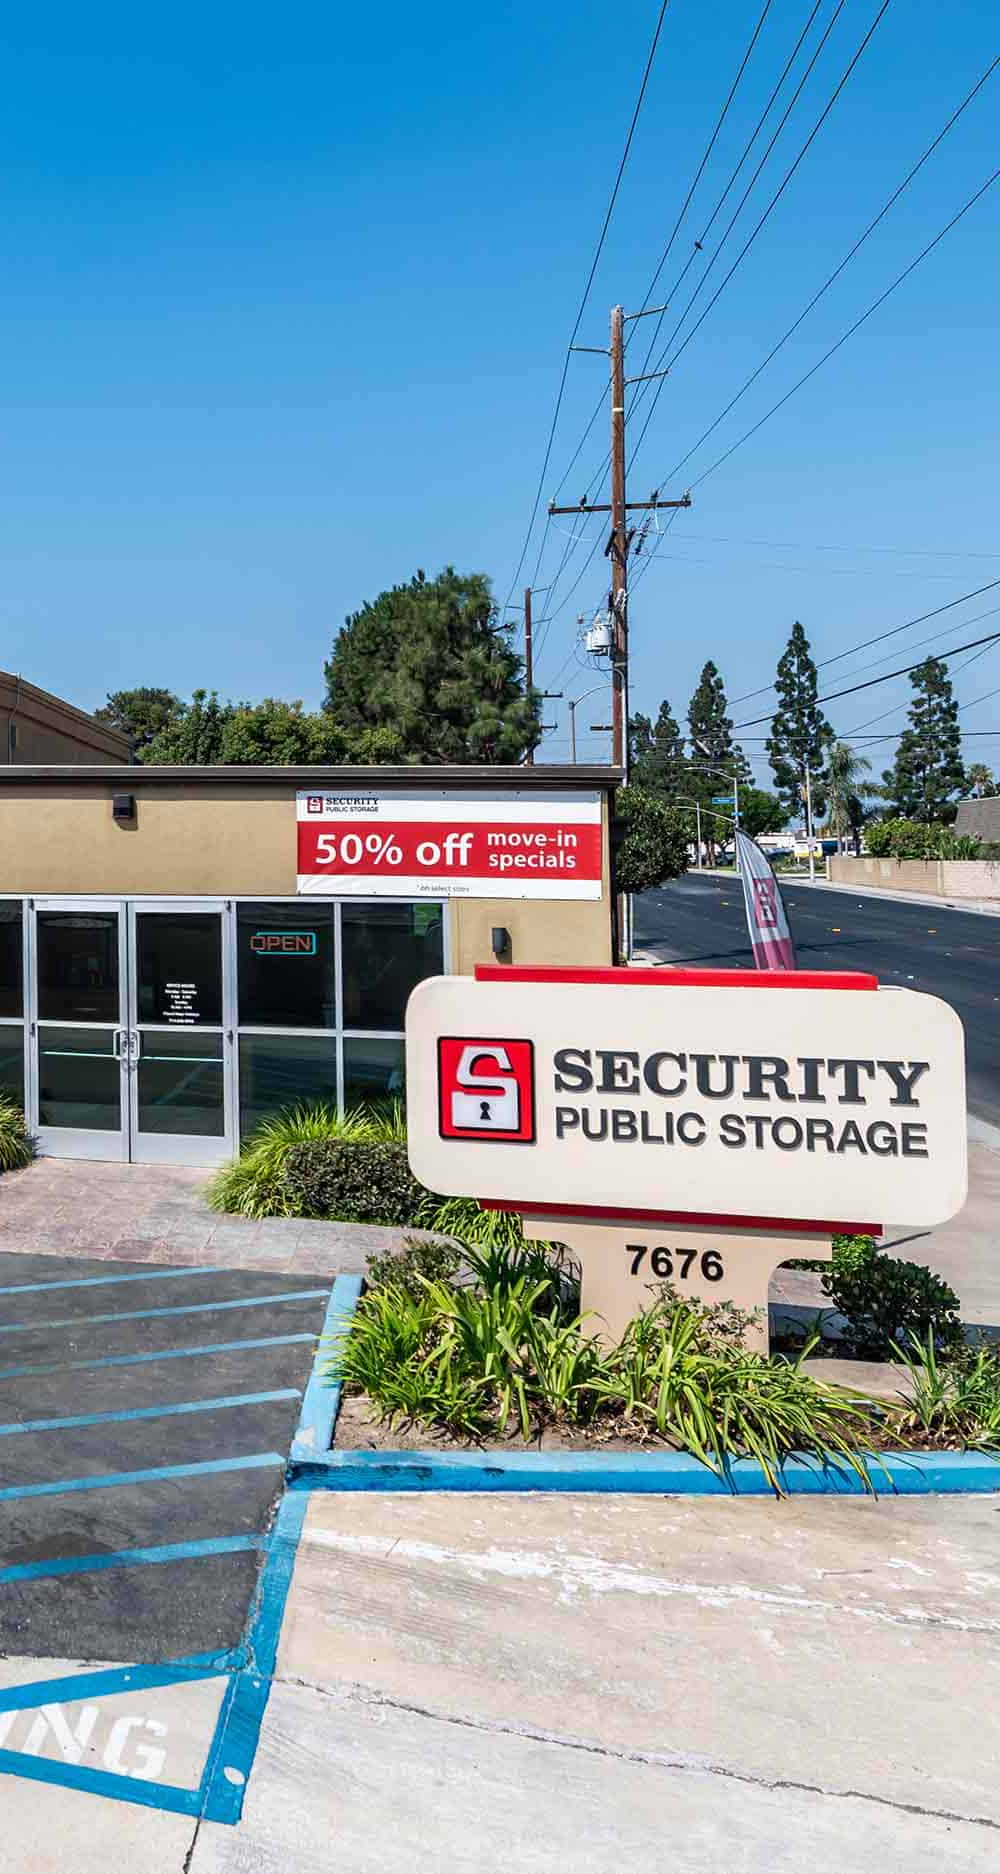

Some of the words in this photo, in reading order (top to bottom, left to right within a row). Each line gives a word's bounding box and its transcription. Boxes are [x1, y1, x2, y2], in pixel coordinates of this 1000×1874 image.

[325, 797, 379, 806] SECURITY
[315, 833, 403, 865] 50%
[415, 832, 474, 866] off
[487, 829, 578, 847] move-in
[488, 850, 577, 872] specials
[250, 935, 312, 951] OPEN
[553, 1047, 930, 1107] SECURITY
[555, 1106, 706, 1147] PUBLIC
[719, 1112, 930, 1158] STORAGE
[625, 1243, 725, 1282] 7676
